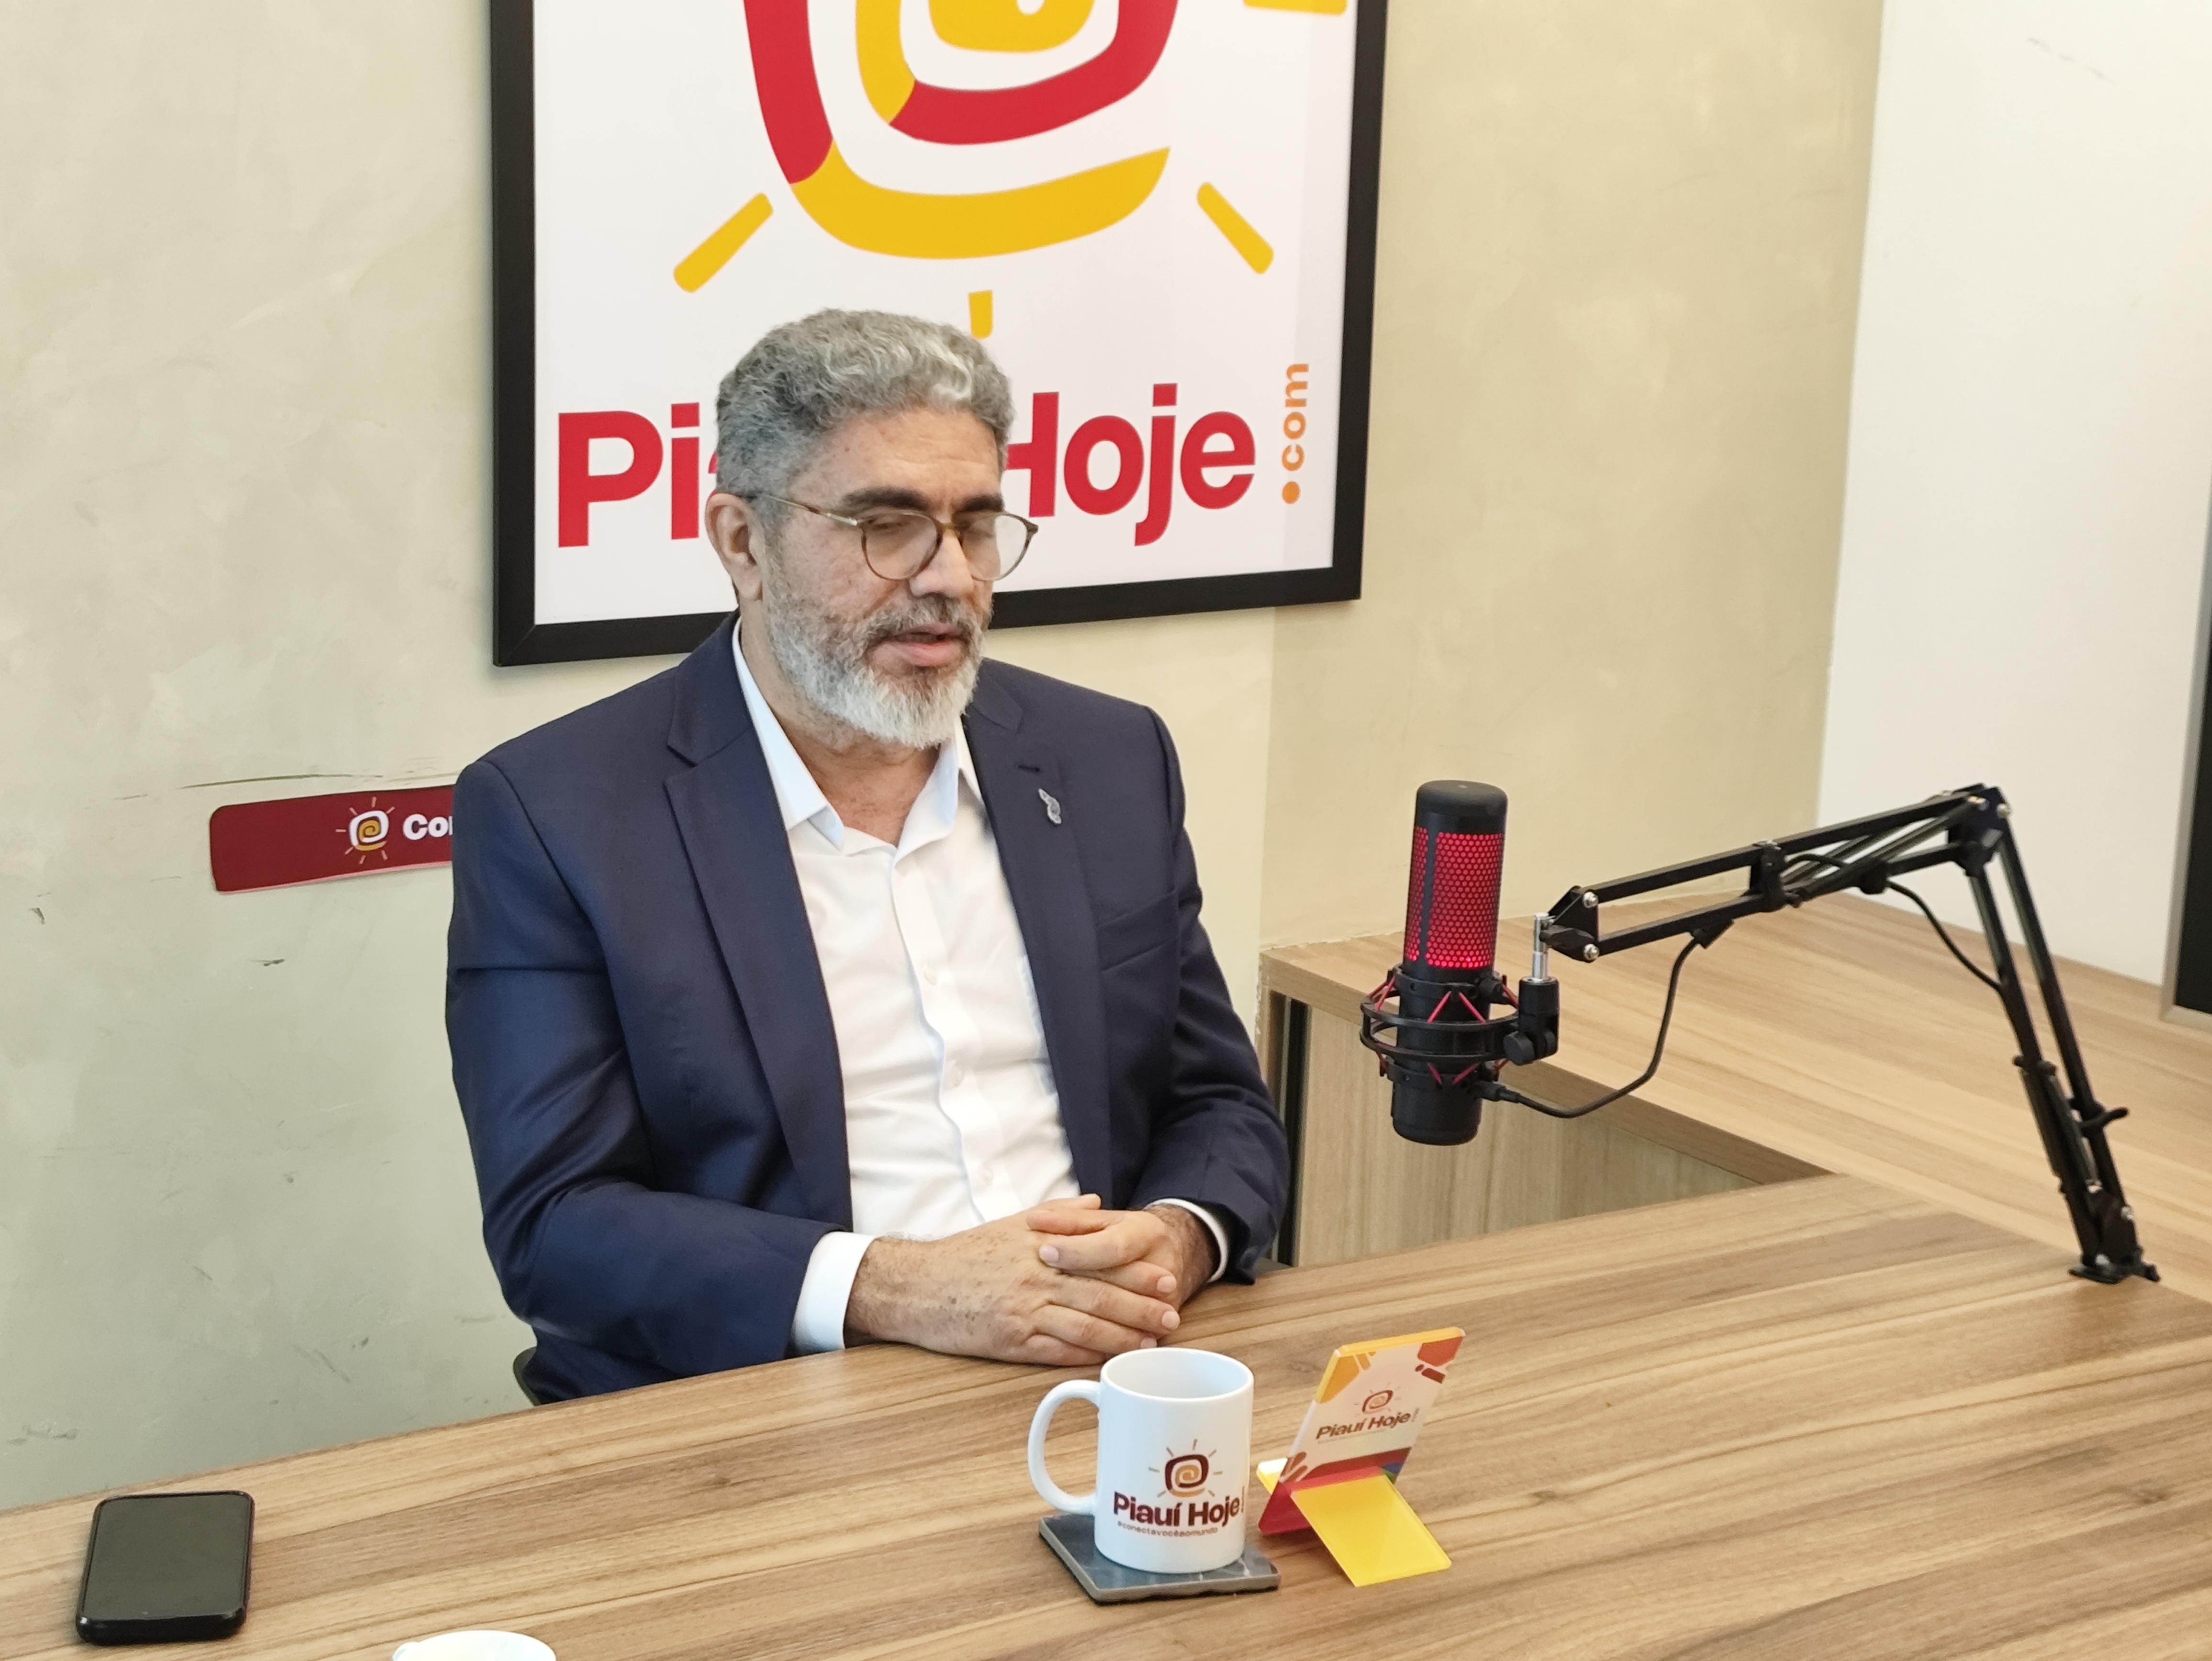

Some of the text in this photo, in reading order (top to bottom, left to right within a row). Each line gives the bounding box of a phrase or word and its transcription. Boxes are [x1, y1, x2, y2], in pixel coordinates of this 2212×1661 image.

[558, 383, 1256, 548] Pi Hoje
[1281, 363, 1309, 504] .com
[1316, 1418, 1367, 1440] Piauí
[1367, 1412, 1411, 1429] Hoje
[1114, 1491, 1183, 1527] Piauí
[1188, 1495, 1240, 1527] Hoje
